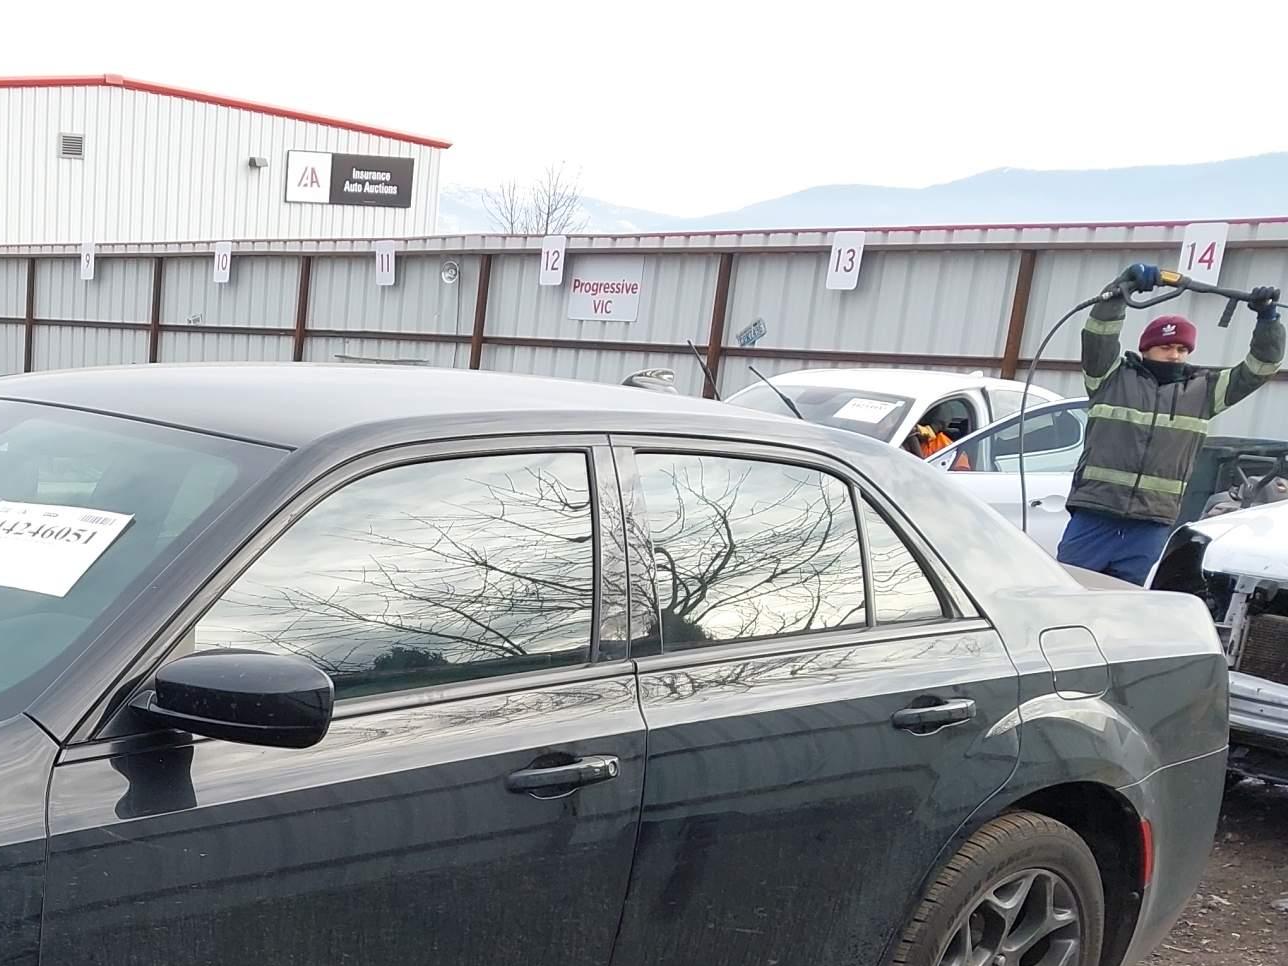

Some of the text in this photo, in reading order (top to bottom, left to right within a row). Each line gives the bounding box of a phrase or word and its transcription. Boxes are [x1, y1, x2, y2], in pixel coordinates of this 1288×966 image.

[352, 168, 391, 181] Insurance
[344, 180, 398, 195] Auto Auctions
[85, 252, 91, 268] 9
[216, 253, 228, 271] 10
[377, 252, 390, 273] 11
[543, 249, 561, 271] 12
[833, 247, 856, 273] 13
[1187, 241, 1217, 271] 14
[572, 278, 639, 296] Progressive
[593, 299, 613, 315] VIC
